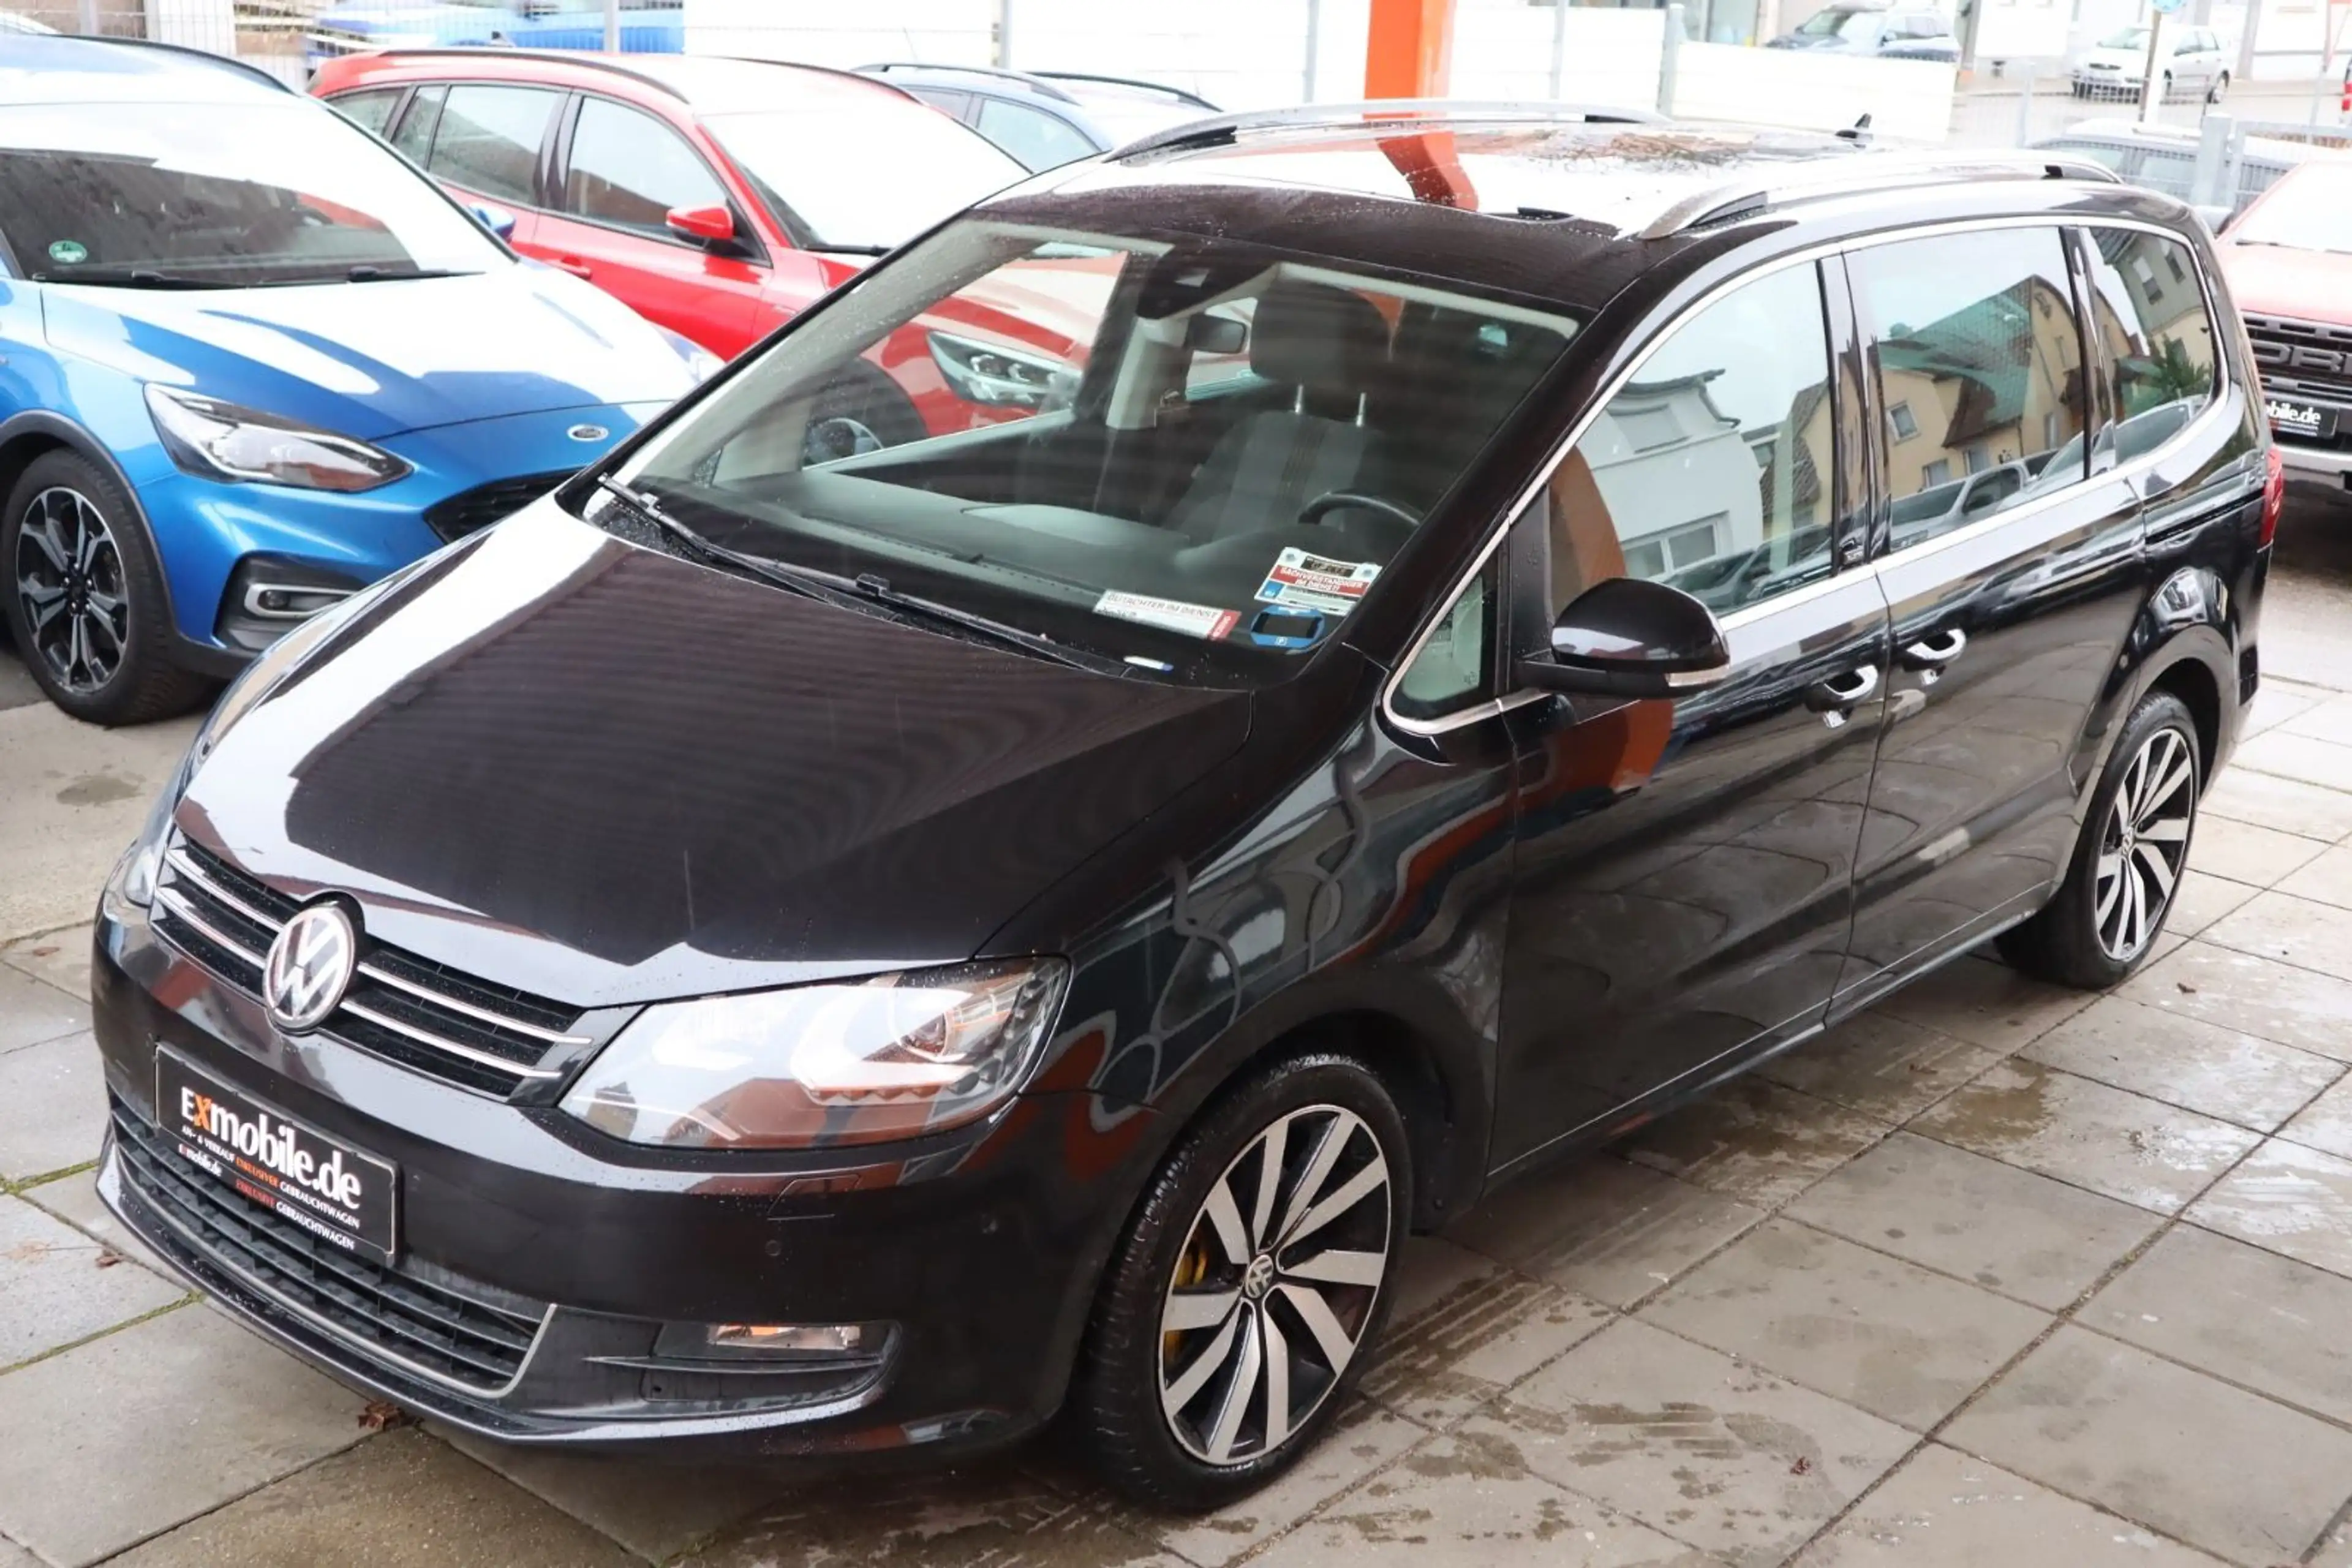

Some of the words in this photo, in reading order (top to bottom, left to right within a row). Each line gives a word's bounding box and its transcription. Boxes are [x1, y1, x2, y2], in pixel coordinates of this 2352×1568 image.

[2250, 339, 2352, 375] OR
[1107, 593, 1164, 611] GUTACHTER
[181, 1086, 361, 1210] EXmobile.de
[276, 1200, 356, 1251] GEBRAUCHTWAGEN
[279, 1181, 361, 1230] GEBRAUCHTWAGEN
